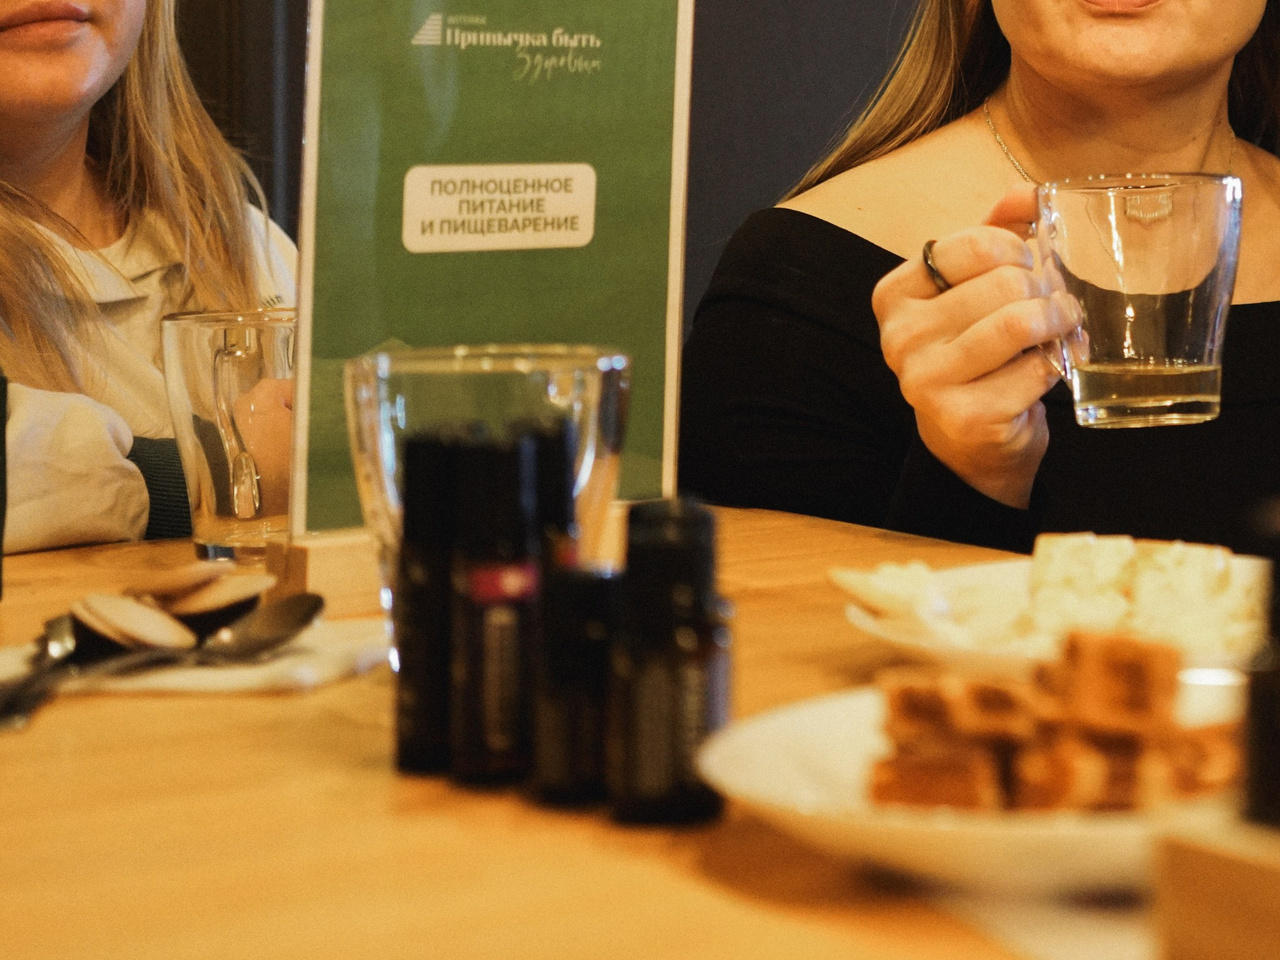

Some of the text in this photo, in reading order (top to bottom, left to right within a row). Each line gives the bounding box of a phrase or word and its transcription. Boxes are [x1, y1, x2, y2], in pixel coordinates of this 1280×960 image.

[446, 27, 602, 49] Привычка быть
[430, 177, 574, 196] ПОЛНОЦЕННОЕ
[458, 198, 546, 215] ПИТАНИЕ
[420, 216, 579, 236] И ПИЩЕВАРЕНИЕ
